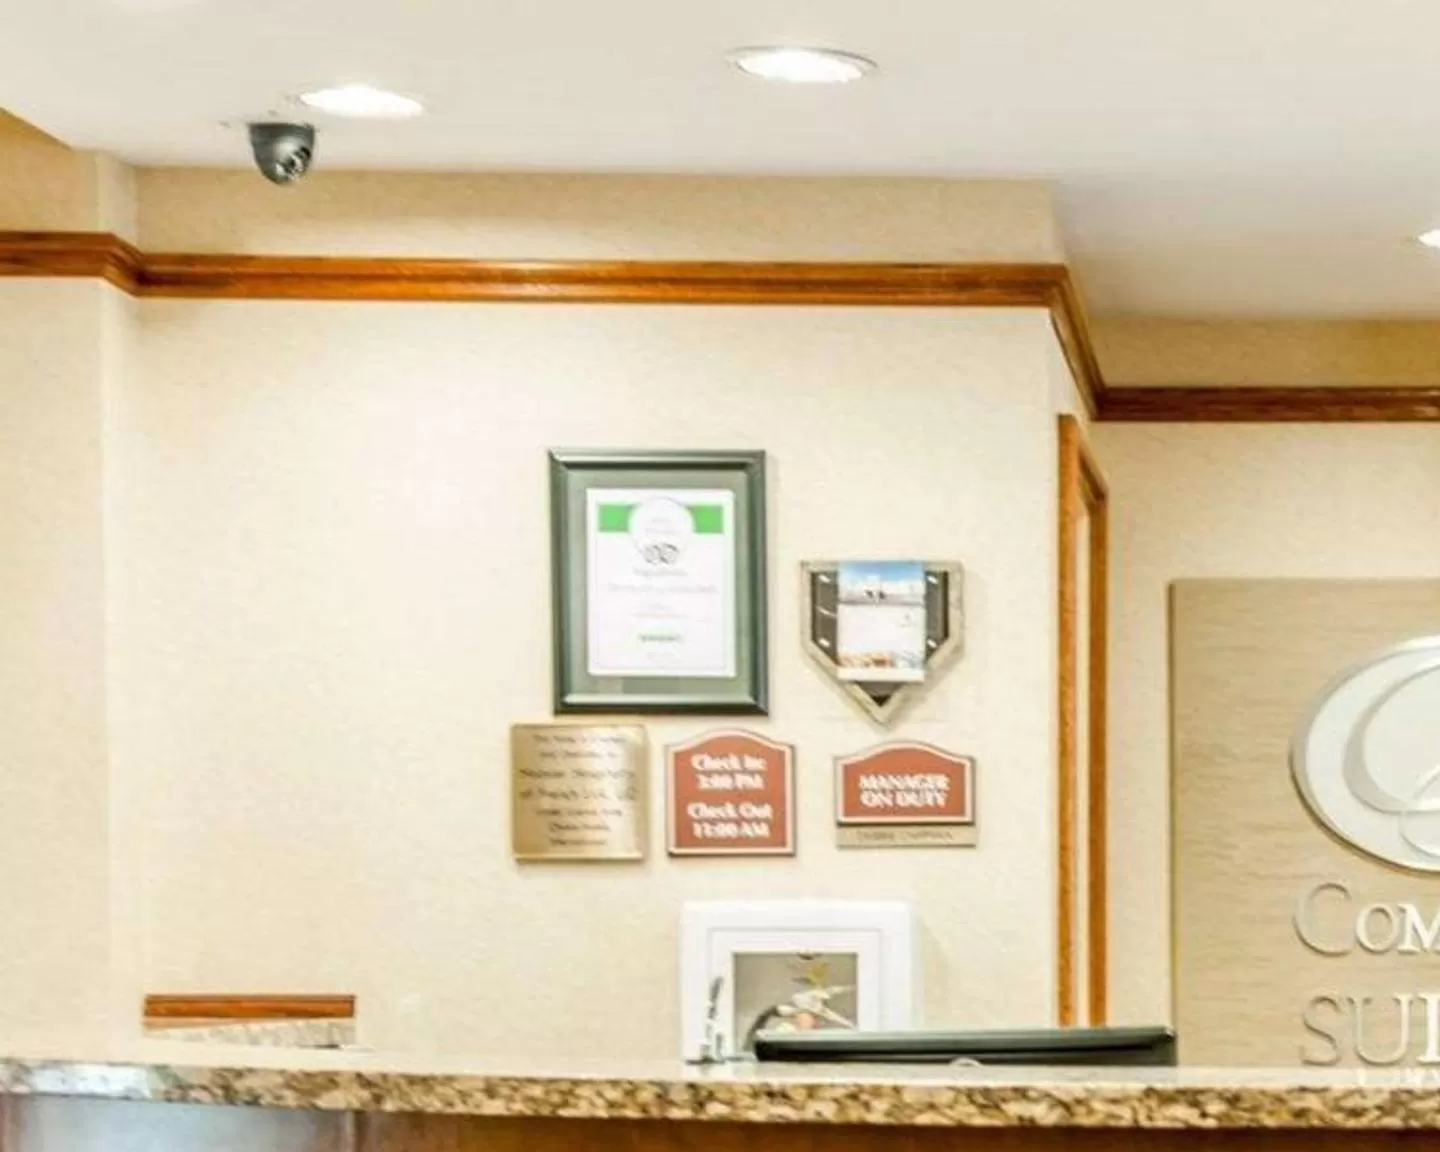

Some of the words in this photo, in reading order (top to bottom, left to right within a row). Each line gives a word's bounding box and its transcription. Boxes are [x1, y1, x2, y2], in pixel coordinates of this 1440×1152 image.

[691, 753, 741, 770] Check
[734, 773, 764, 790] PM
[859, 773, 950, 790] MANAGER
[860, 789, 893, 807] ON
[894, 789, 948, 808] DUTY
[687, 802, 738, 820] Check
[739, 801, 773, 821] Out
[739, 820, 770, 838] AM
